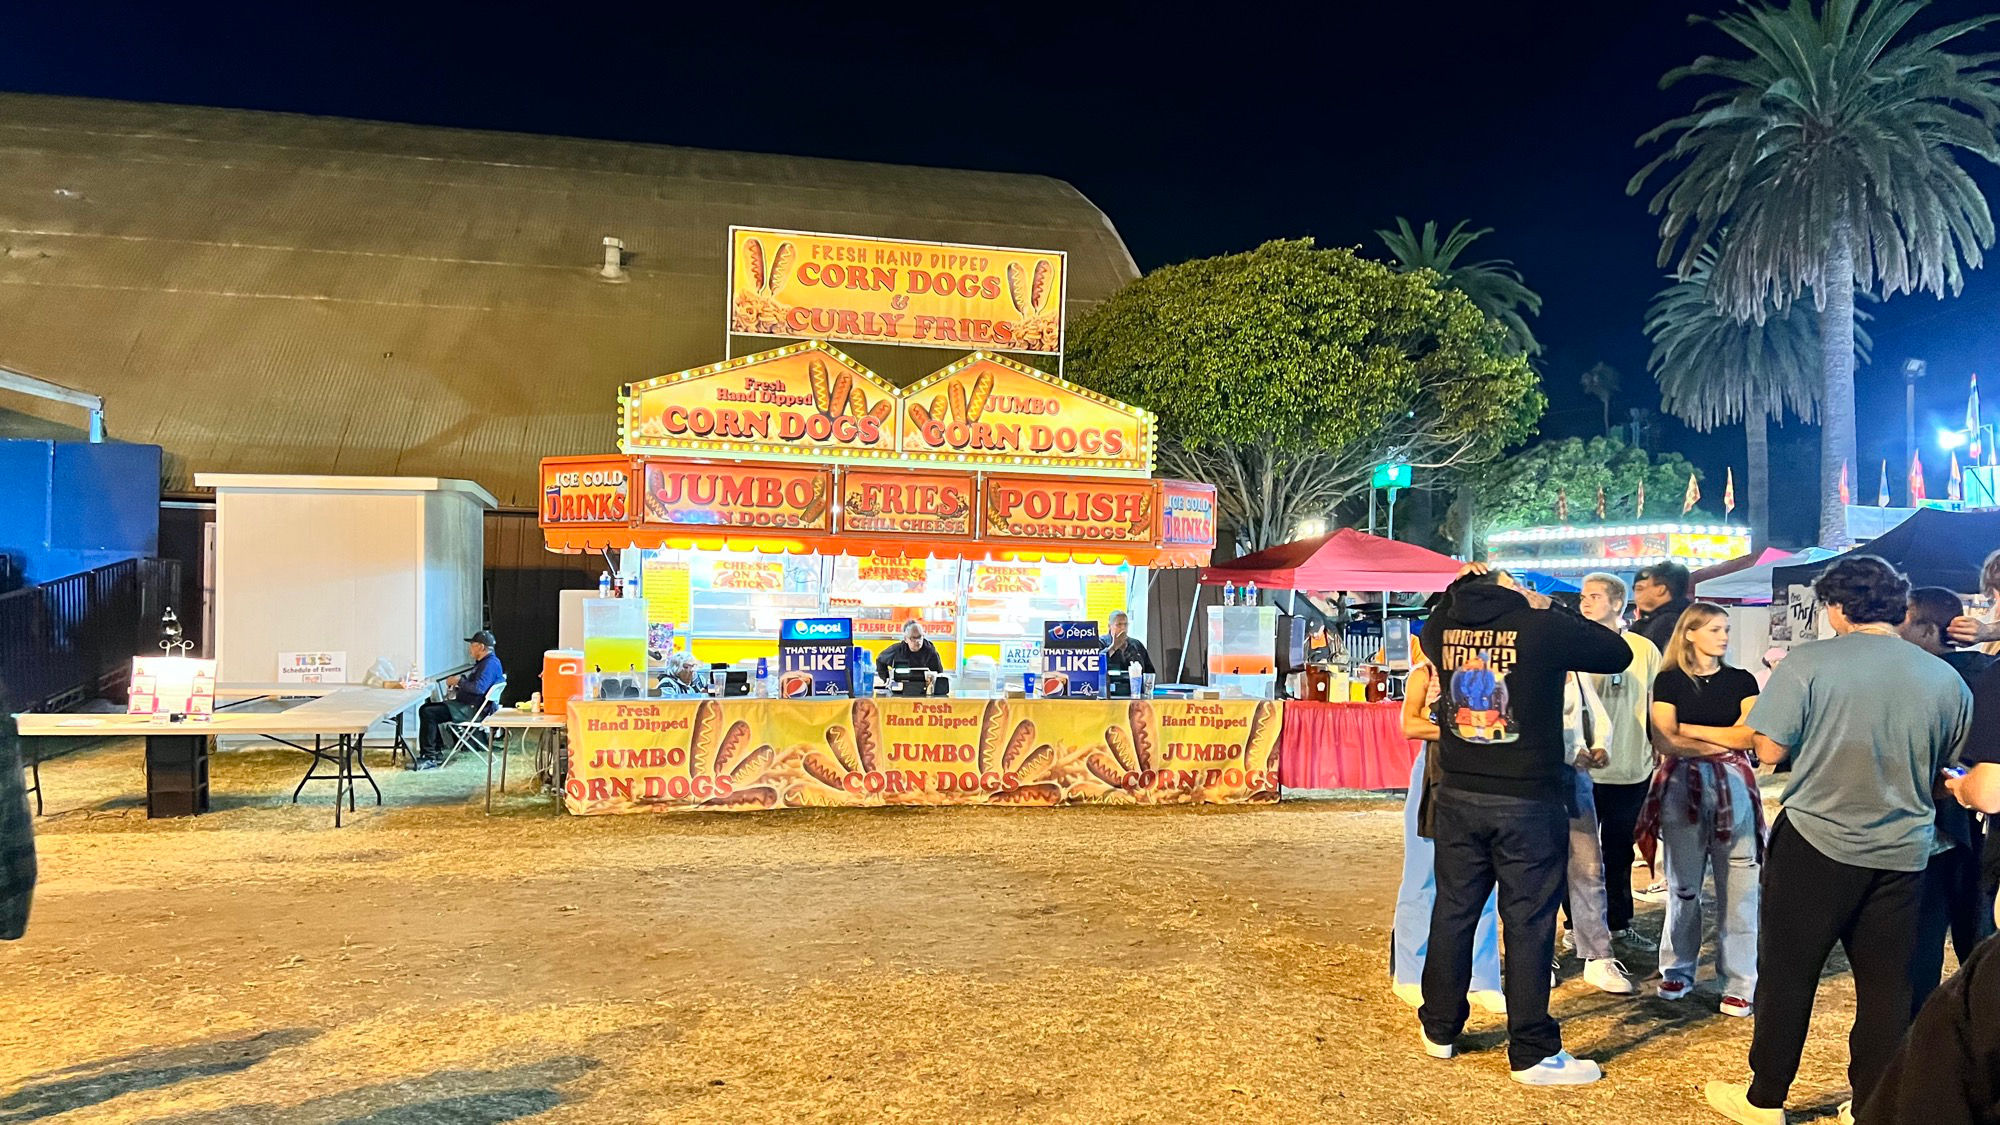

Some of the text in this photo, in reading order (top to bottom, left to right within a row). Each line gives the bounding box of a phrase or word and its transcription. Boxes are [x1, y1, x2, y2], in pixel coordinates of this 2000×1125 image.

[811, 244, 989, 273] FRESH HAND DIPPED
[796, 262, 1001, 300] CORN DOGS
[890, 294, 908, 311] &
[785, 306, 1014, 345] CURLY FRIES
[744, 377, 786, 392] Fresh
[716, 388, 813, 406] Hand Dipped
[984, 395, 1060, 415] JUMBO
[661, 405, 881, 444] CORN DOGS
[921, 420, 1123, 456] CORN DOGS
[555, 470, 624, 488] ICE COLD
[656, 472, 815, 510] JUMBO
[860, 482, 959, 516] FRIES
[547, 492, 625, 520] DRINKS
[997, 488, 1144, 523] POLISH
[1169, 495, 1210, 513] ICE COLD
[668, 508, 800, 527] CORN DOGS
[848, 515, 966, 533] CHILI CHEESE
[1008, 523, 1127, 539] CORN DOGS
[1163, 515, 1211, 543] DRINKS
[722, 560, 770, 571] CHEESE
[871, 557, 912, 566] CURLY
[985, 566, 1029, 575] CHEESE
[732, 570, 750, 579] ON
[727, 579, 766, 589] STICK
[990, 583, 1025, 593] STICK
[809, 623, 842, 635] pepsi
[858, 623, 886, 633] FRESH
[1066, 627, 1096, 639] pepsi
[784, 646, 847, 655] THAT'S WHAT
[785, 654, 846, 671] I LIKE
[1043, 655, 1100, 672] I LIKE
[617, 704, 660, 717] Fresh
[912, 702, 953, 714] Fresh
[1186, 703, 1224, 715] Fresh
[587, 717, 688, 733] Hand Dipped
[886, 714, 978, 729] Hand Dipped
[1162, 715, 1247, 730] Hand Dipped
[589, 747, 686, 769] JUMBO
[887, 743, 976, 763] JUMBO
[1162, 743, 1242, 762] JUMBO
[566, 775, 733, 801] ORN DOGS
[842, 770, 1020, 793] CORN DOGS
[1122, 768, 1279, 791] CORN DOGS
